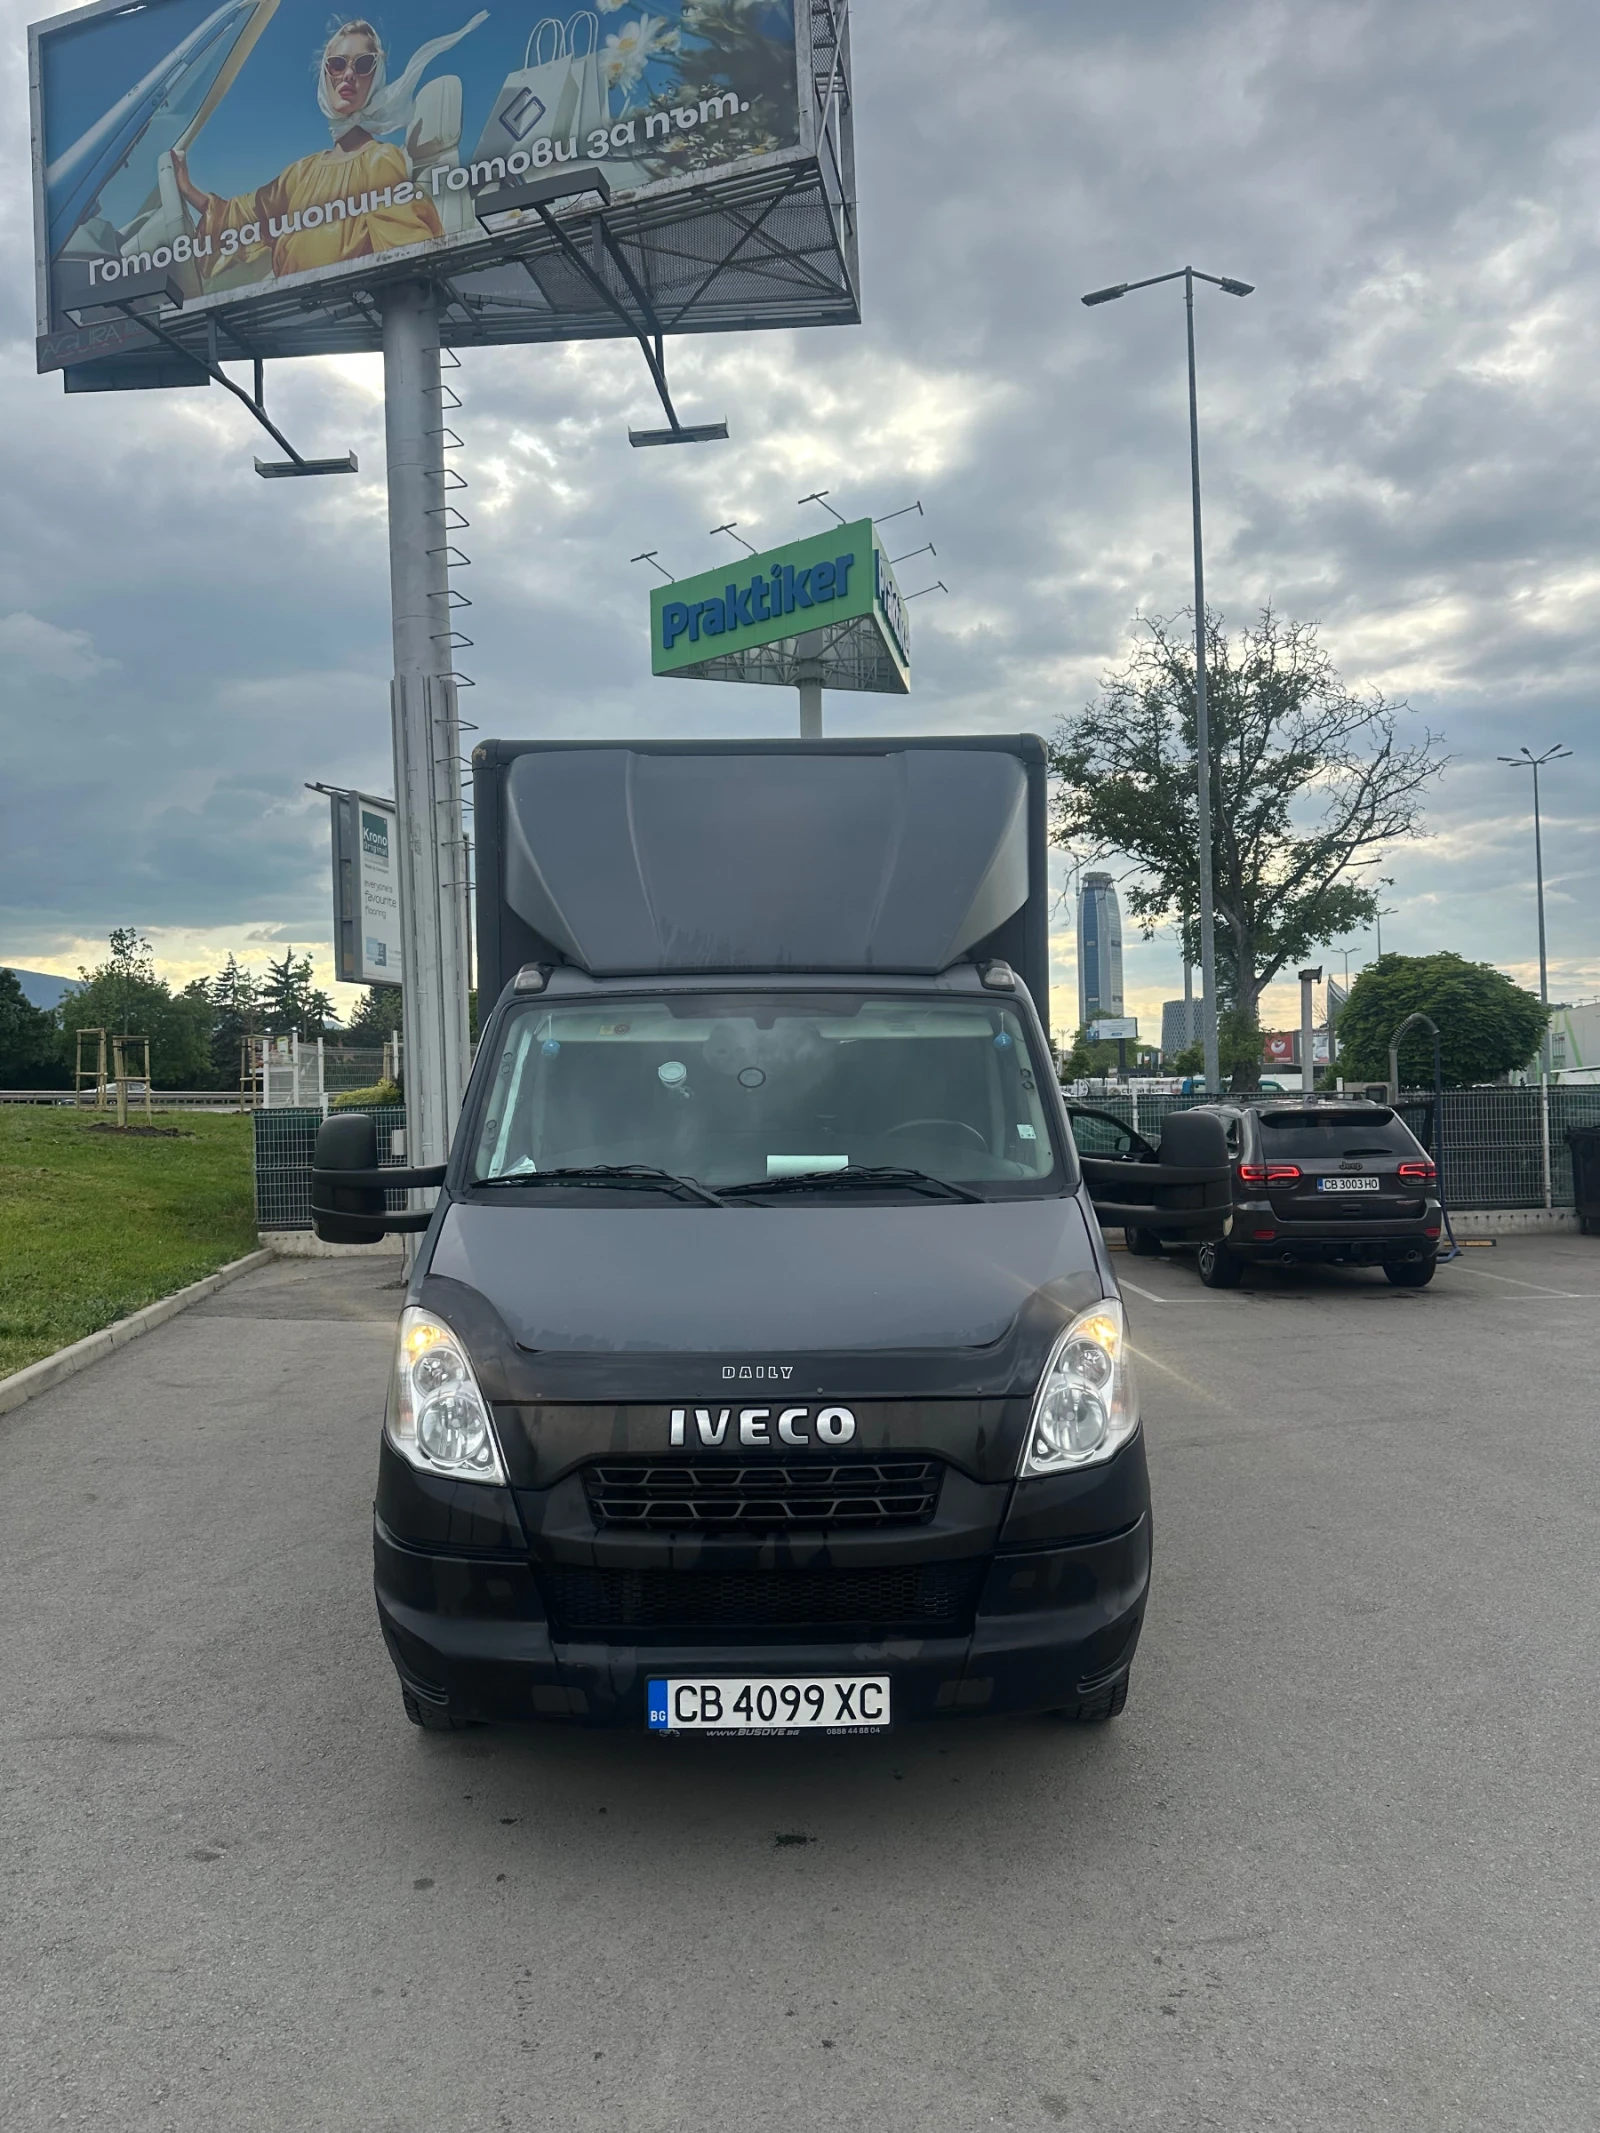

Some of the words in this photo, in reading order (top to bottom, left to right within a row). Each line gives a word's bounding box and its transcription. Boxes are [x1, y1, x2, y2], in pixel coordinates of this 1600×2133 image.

[89, 235, 212, 285] Готови
[219, 221, 261, 256] за
[268, 181, 424, 237] шопинг.
[431, 135, 578, 196] Готови
[586, 119, 636, 159] за
[645, 91, 750, 139] път.
[662, 553, 854, 649] Praktiker
[363, 827, 388, 846] Krono
[364, 880, 393, 893] everyone's
[365, 890, 397, 908] favourite
[365, 905, 387, 919] flooring
[1122, 1086, 1145, 1094] СТОЙ
[1339, 1161, 1363, 1171] Jeep
[1340, 1179, 1363, 1189] 3003
[722, 1366, 793, 1379] DAILY
[670, 1407, 856, 1446] IVECO
[674, 1684, 723, 1722] CB
[732, 1684, 825, 1722] 4099
[834, 1683, 883, 1720] XC
[650, 1710, 667, 1722] BG
